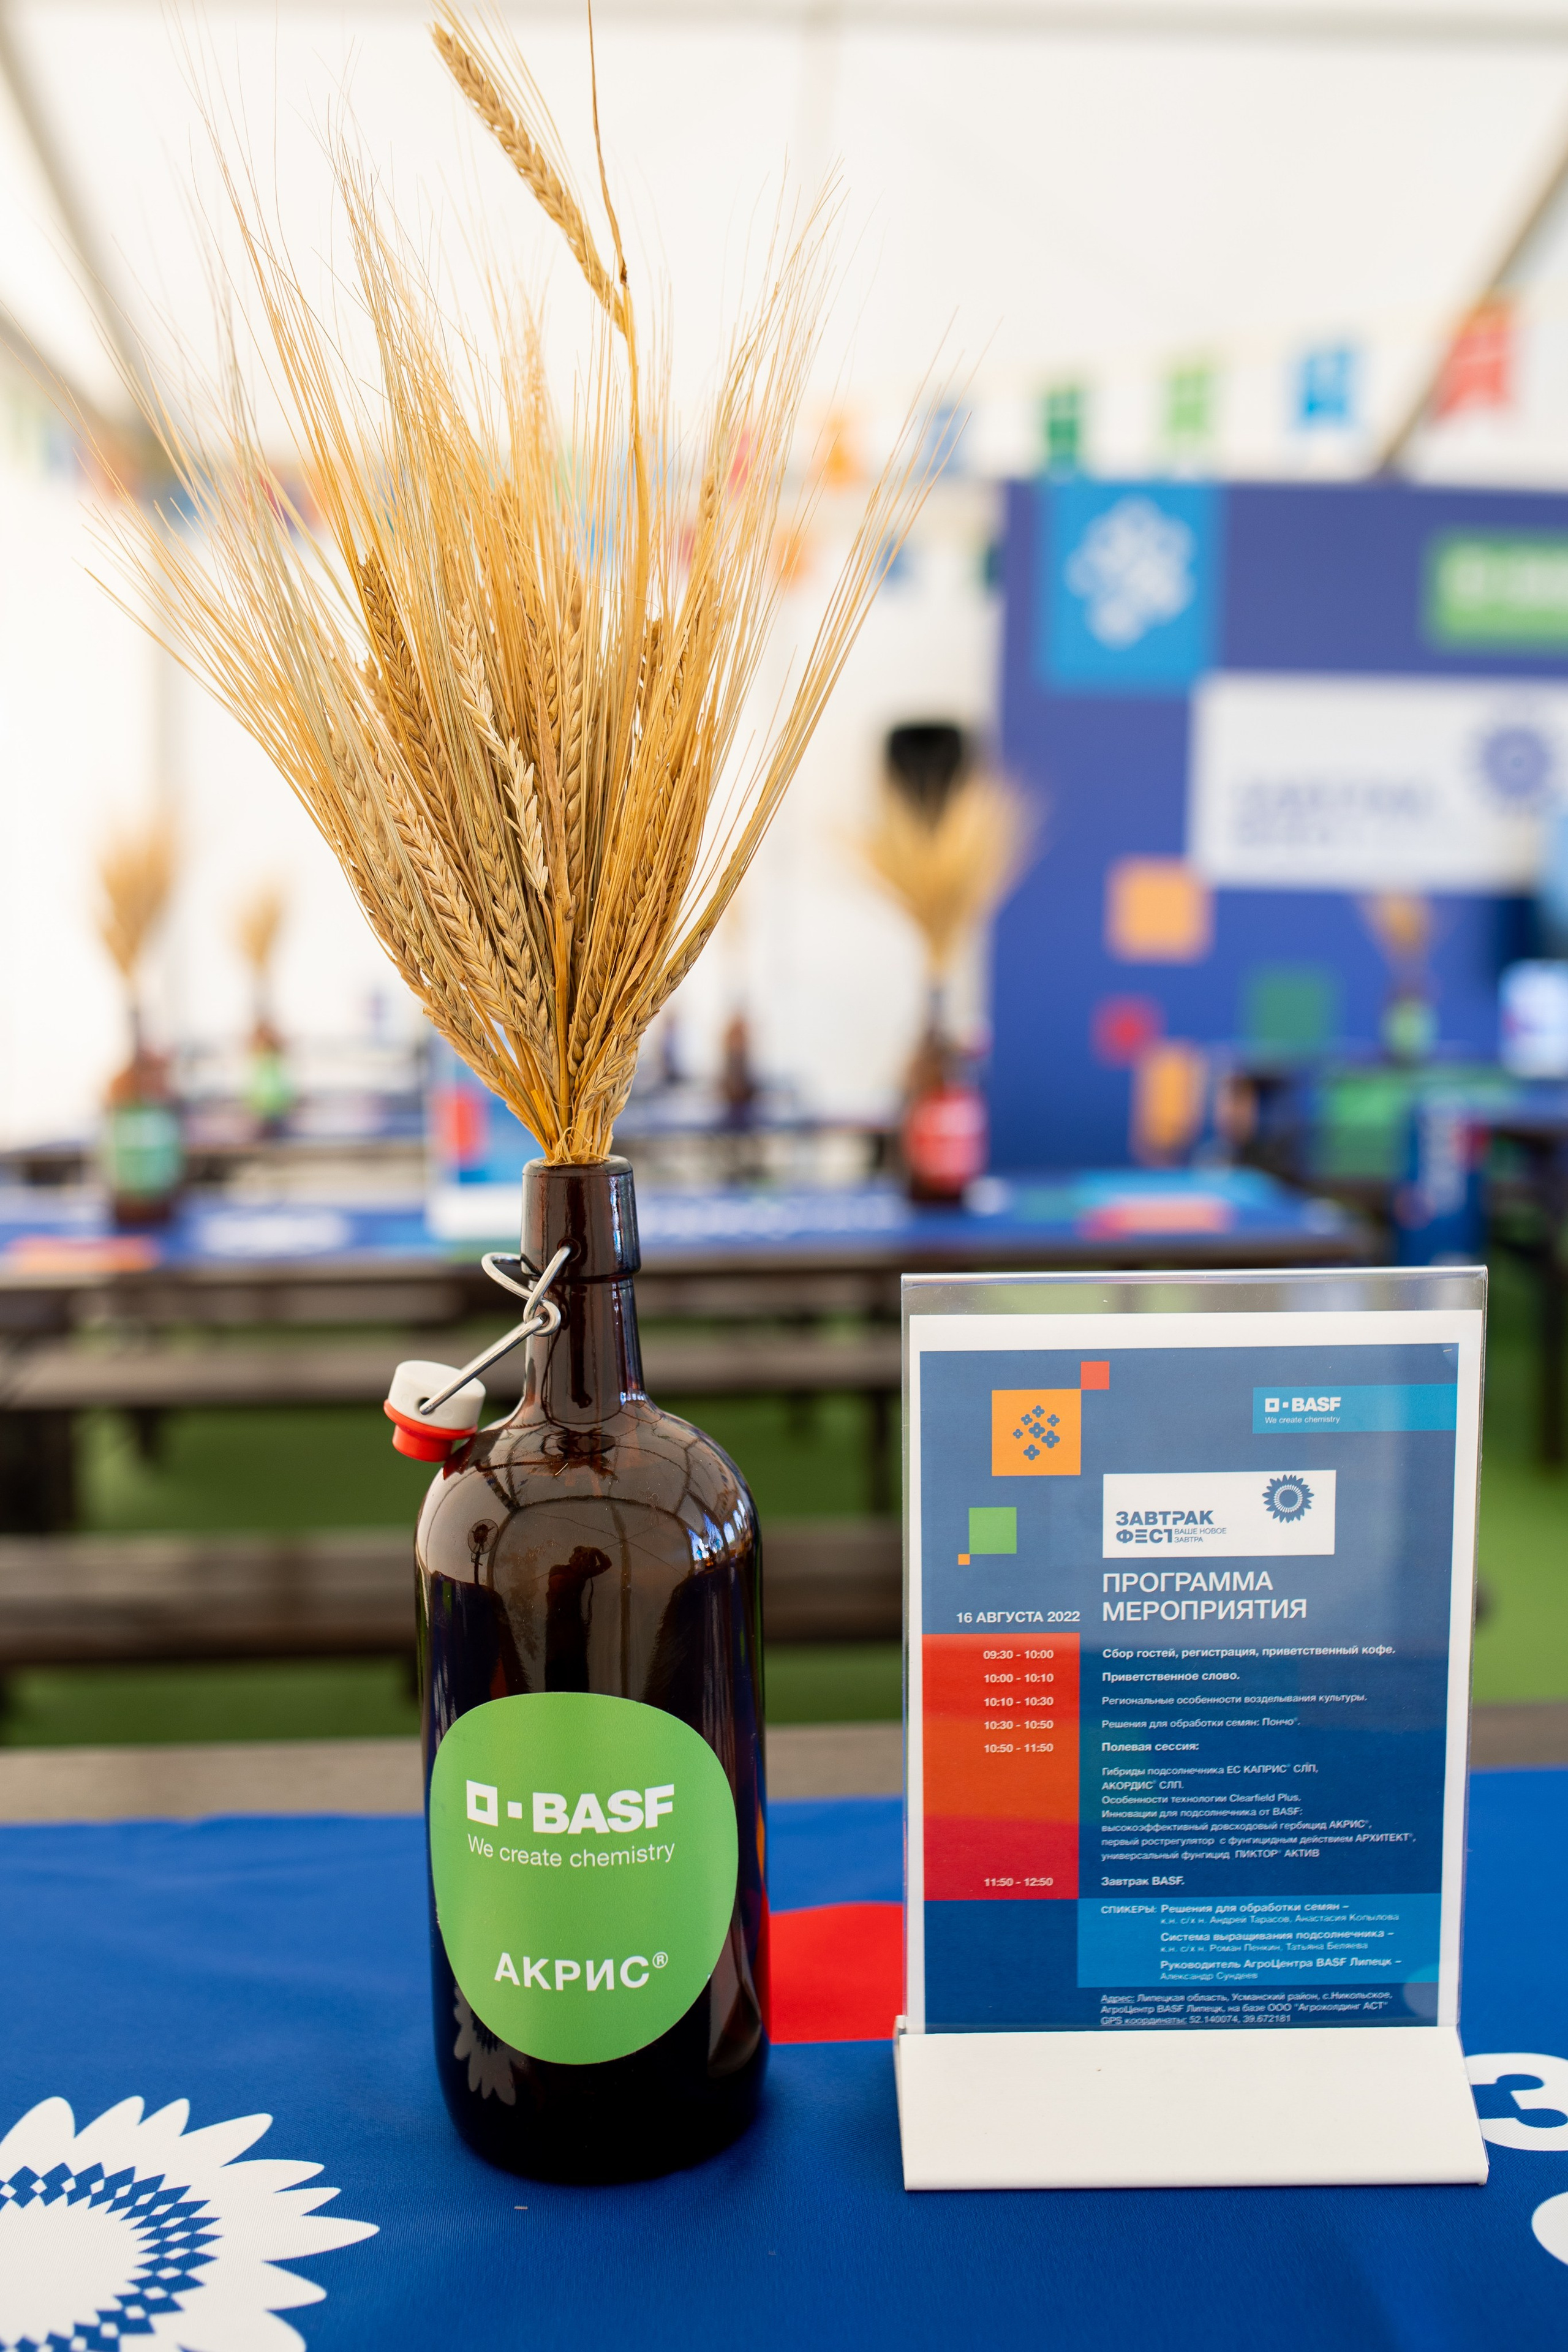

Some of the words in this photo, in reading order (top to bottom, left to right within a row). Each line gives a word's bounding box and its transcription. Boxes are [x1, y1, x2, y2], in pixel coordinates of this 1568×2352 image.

[1291, 1396, 1341, 1412] BASF
[1115, 1510, 1214, 1526] ЗАВТРАК
[1103, 1572, 1273, 1593] ПРОГРАММА
[1103, 1599, 1306, 1621] МЕРОПРИЯТИЯ
[956, 1612, 973, 1623] 16
[976, 1611, 1044, 1623] АВГУСТА
[1047, 1611, 1080, 1623] 2022
[983, 1650, 1014, 1659] 09:30
[1024, 1649, 1054, 1659] 10:00
[1102, 1648, 1134, 1660] Сбор
[1136, 1648, 1179, 1659] гостей,
[1262, 1646, 1359, 1657] приветственный
[1362, 1645, 1395, 1656] кофе.
[984, 1673, 1014, 1683] 10:00
[1024, 1673, 1054, 1683] 10:10
[1102, 1672, 1199, 1683] Приветственное
[984, 1697, 1014, 1706] 10:10
[1024, 1697, 1054, 1706] 10:30
[984, 1721, 1014, 1730] 10:30
[1023, 1720, 1054, 1729] 10:50
[984, 1744, 1014, 1753] 10:50
[1023, 1743, 1054, 1752] 11:50
[532, 1784, 674, 1834] BASF
[467, 1833, 494, 1858] We
[499, 1847, 562, 1868] create
[570, 1843, 675, 1868] chemistry
[984, 1877, 1014, 1887] 11:50
[1023, 1877, 1054, 1887] 12:50
[1101, 1877, 1149, 1887] Завтрак
[1239, 1903, 1302, 1913] обработки
